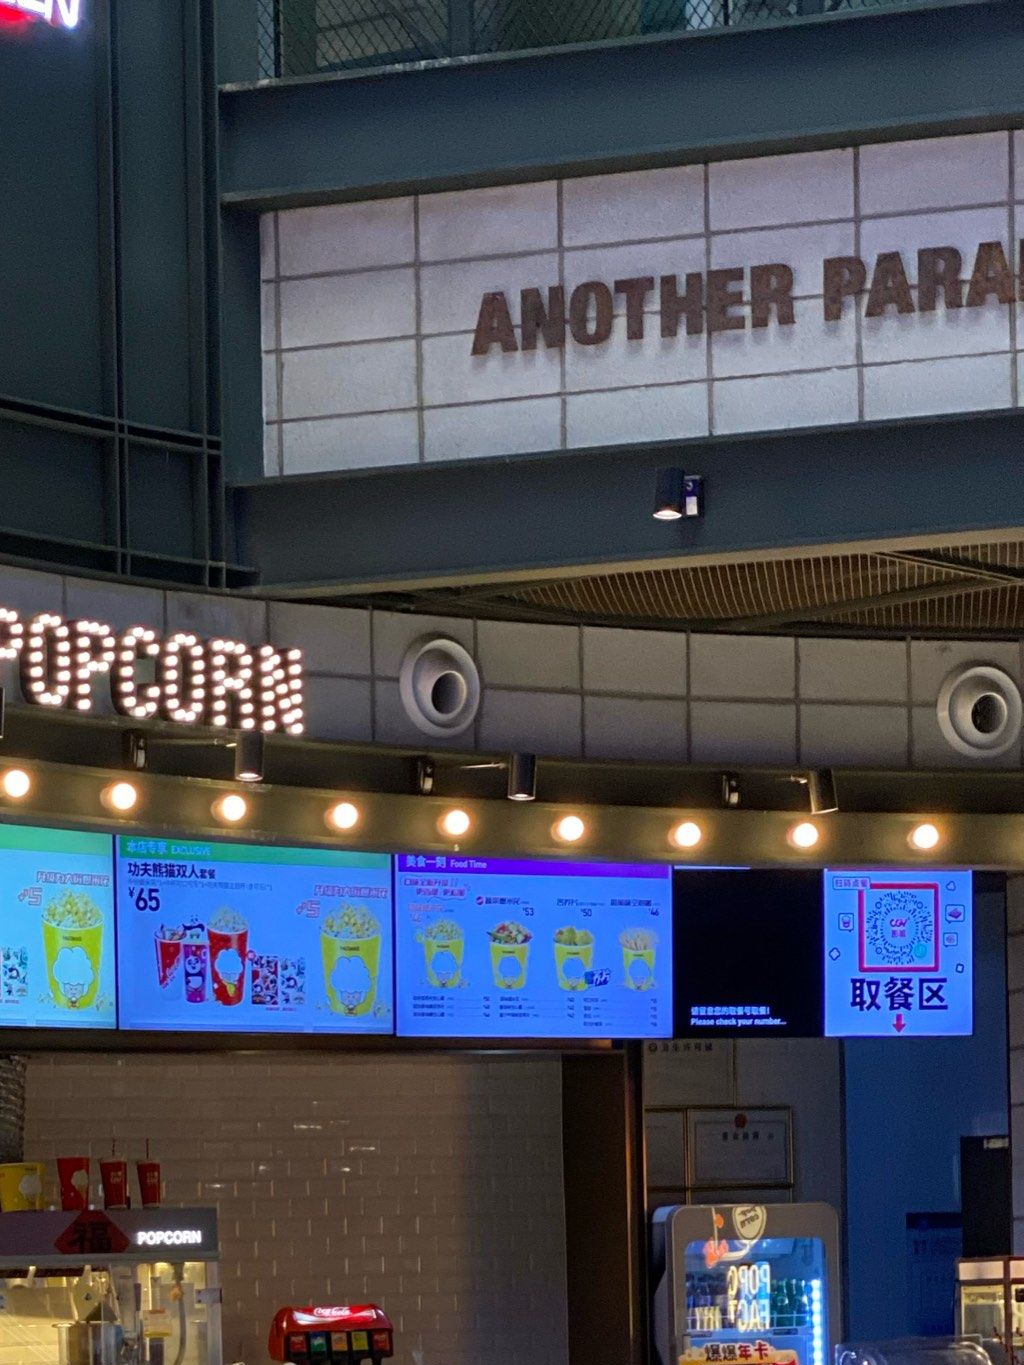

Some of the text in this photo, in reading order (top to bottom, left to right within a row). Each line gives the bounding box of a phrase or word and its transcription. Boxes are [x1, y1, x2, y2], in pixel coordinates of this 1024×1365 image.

[470, 240, 1024, 357] ANOTHER PARA
[127, 862, 216, 880] 功夫熊猫双人套餐
[450, 859, 468, 868] Food
[469, 860, 487, 869] Time
[128, 887, 161, 912] ¥65
[850, 976, 949, 1012] 取餐区
[691, 1018, 714, 1026] Please
[716, 1018, 736, 1026] check
[738, 1018, 753, 1027] your
[137, 1230, 202, 1245] POPCORN
[705, 1341, 769, 1362] 爆爆年卡
